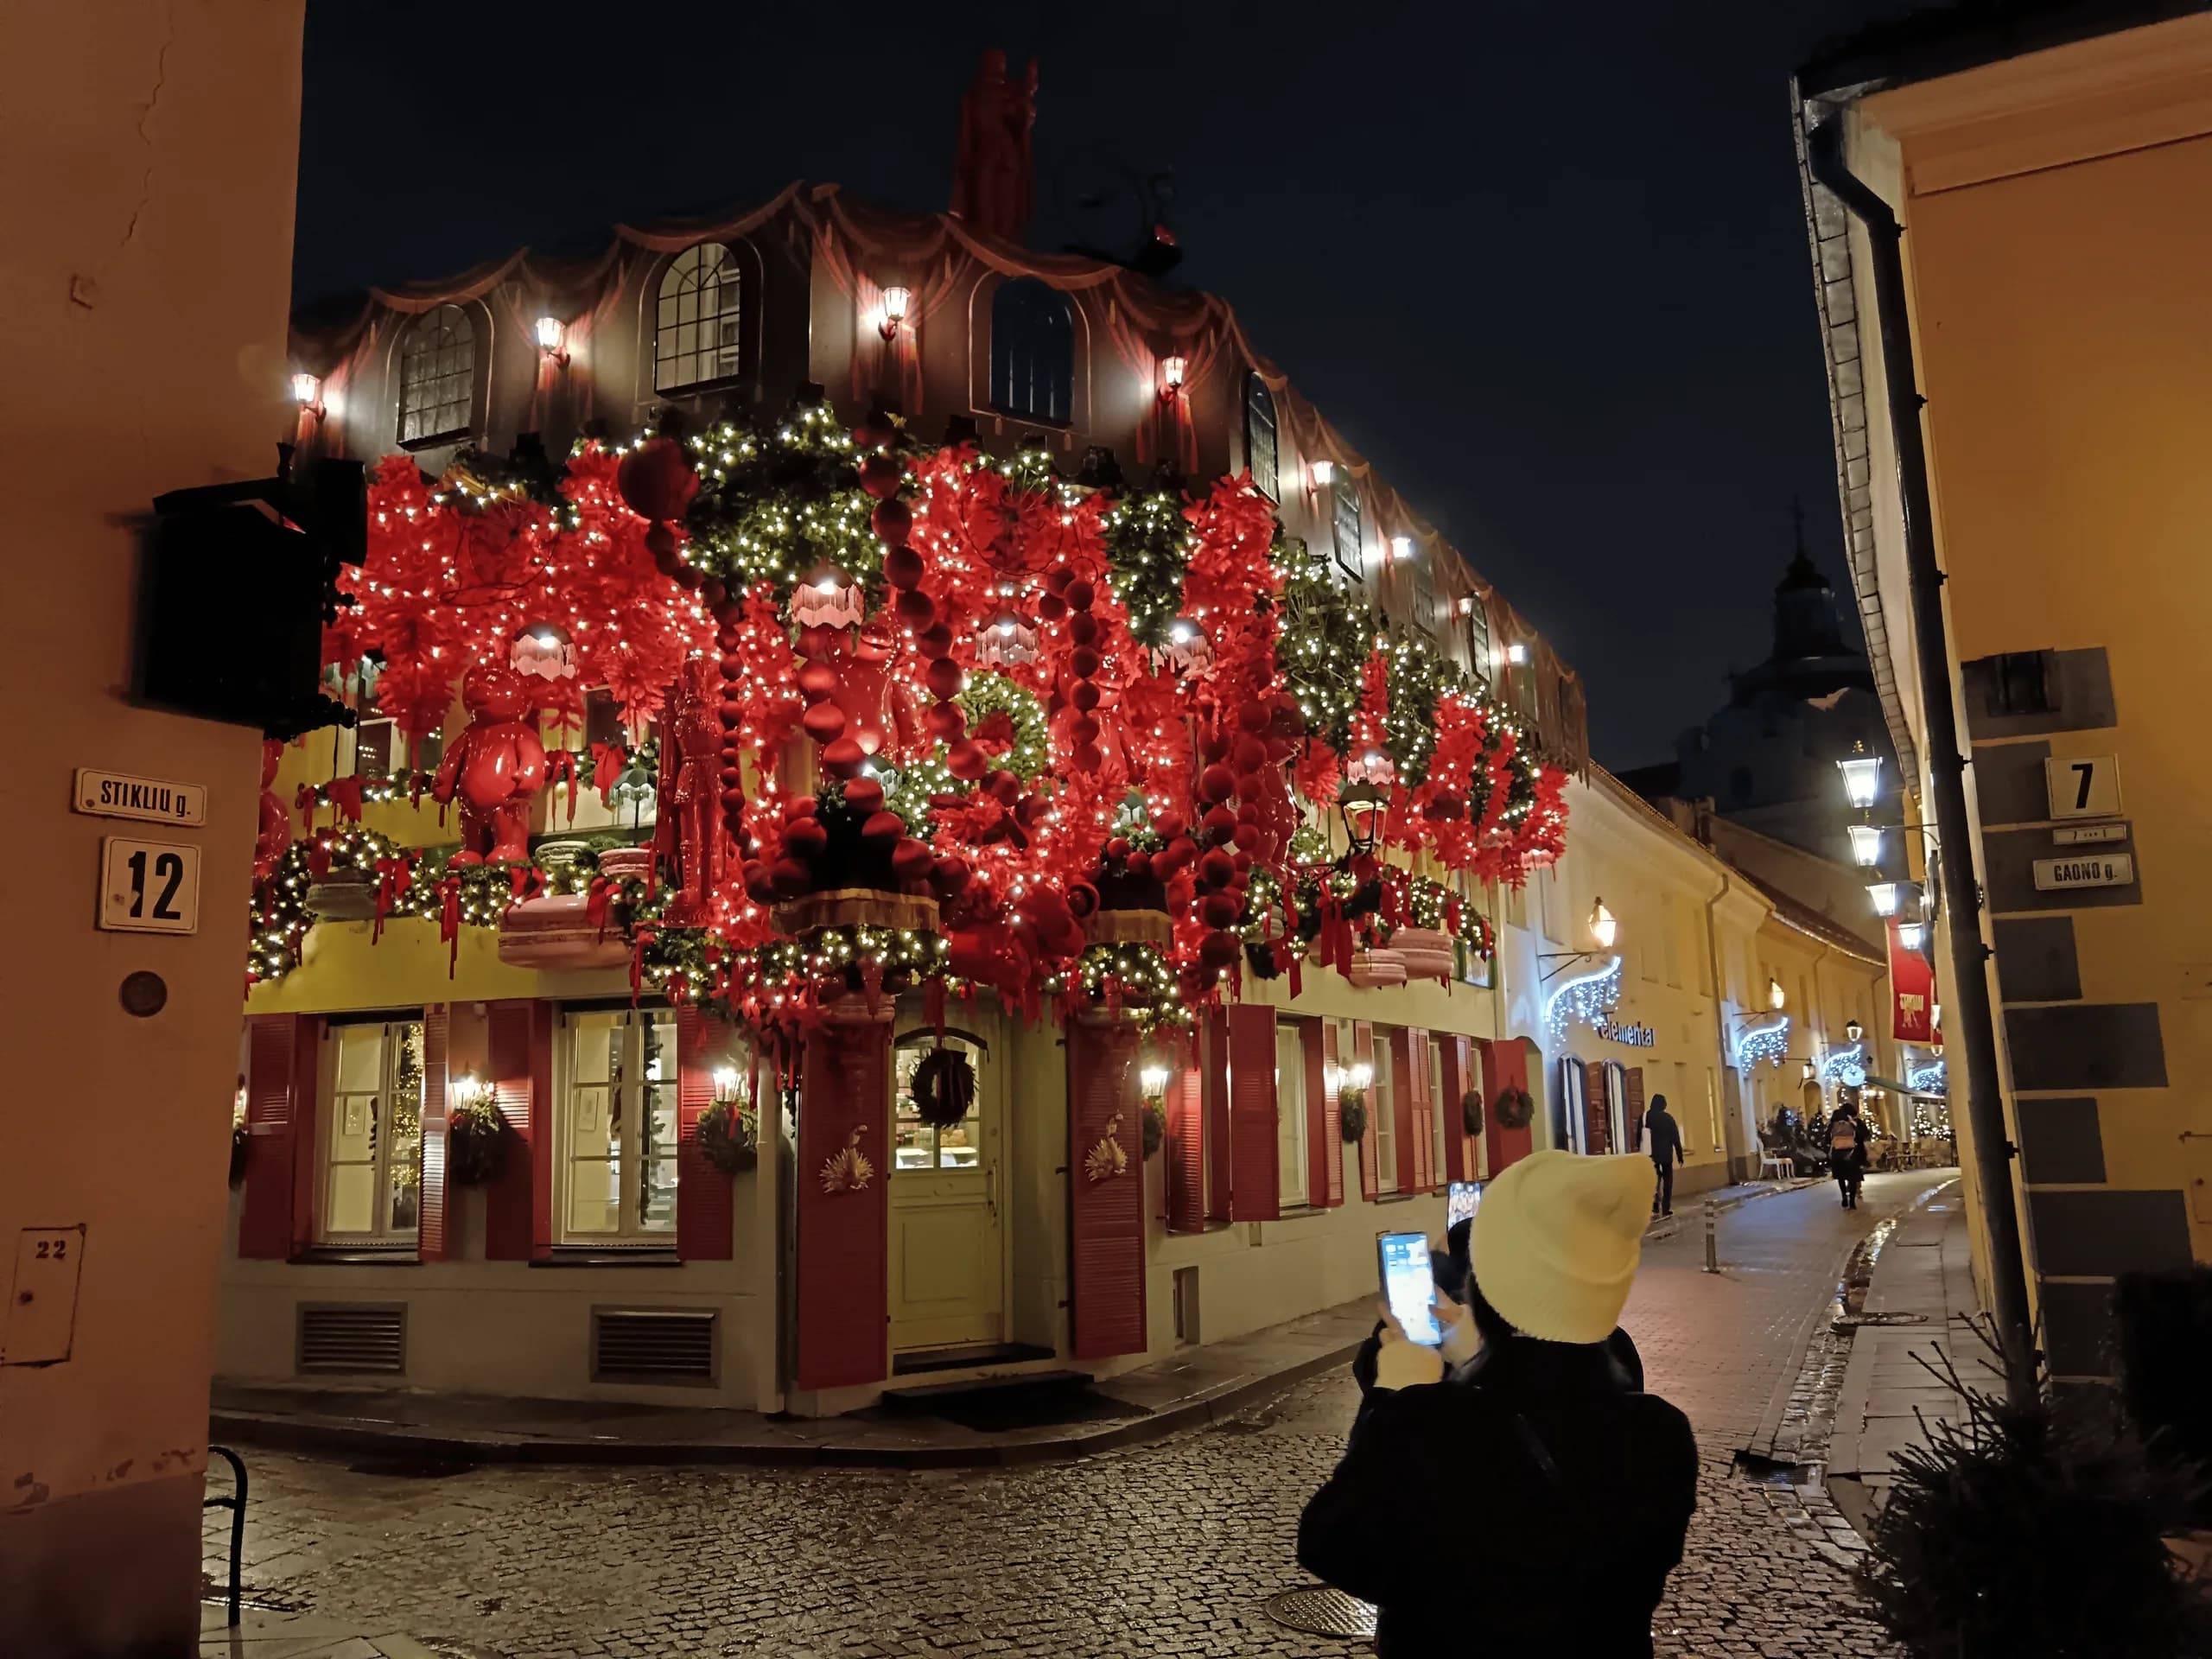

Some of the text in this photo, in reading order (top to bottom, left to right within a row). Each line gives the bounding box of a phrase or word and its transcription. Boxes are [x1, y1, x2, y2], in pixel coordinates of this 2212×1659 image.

[100, 779, 191, 817] STIKLIŲ g.
[2071, 762, 2094, 810] 7
[128, 850, 183, 920] 12
[2053, 861, 2118, 881] GAONO g.
[35, 1239, 67, 1260] 22
